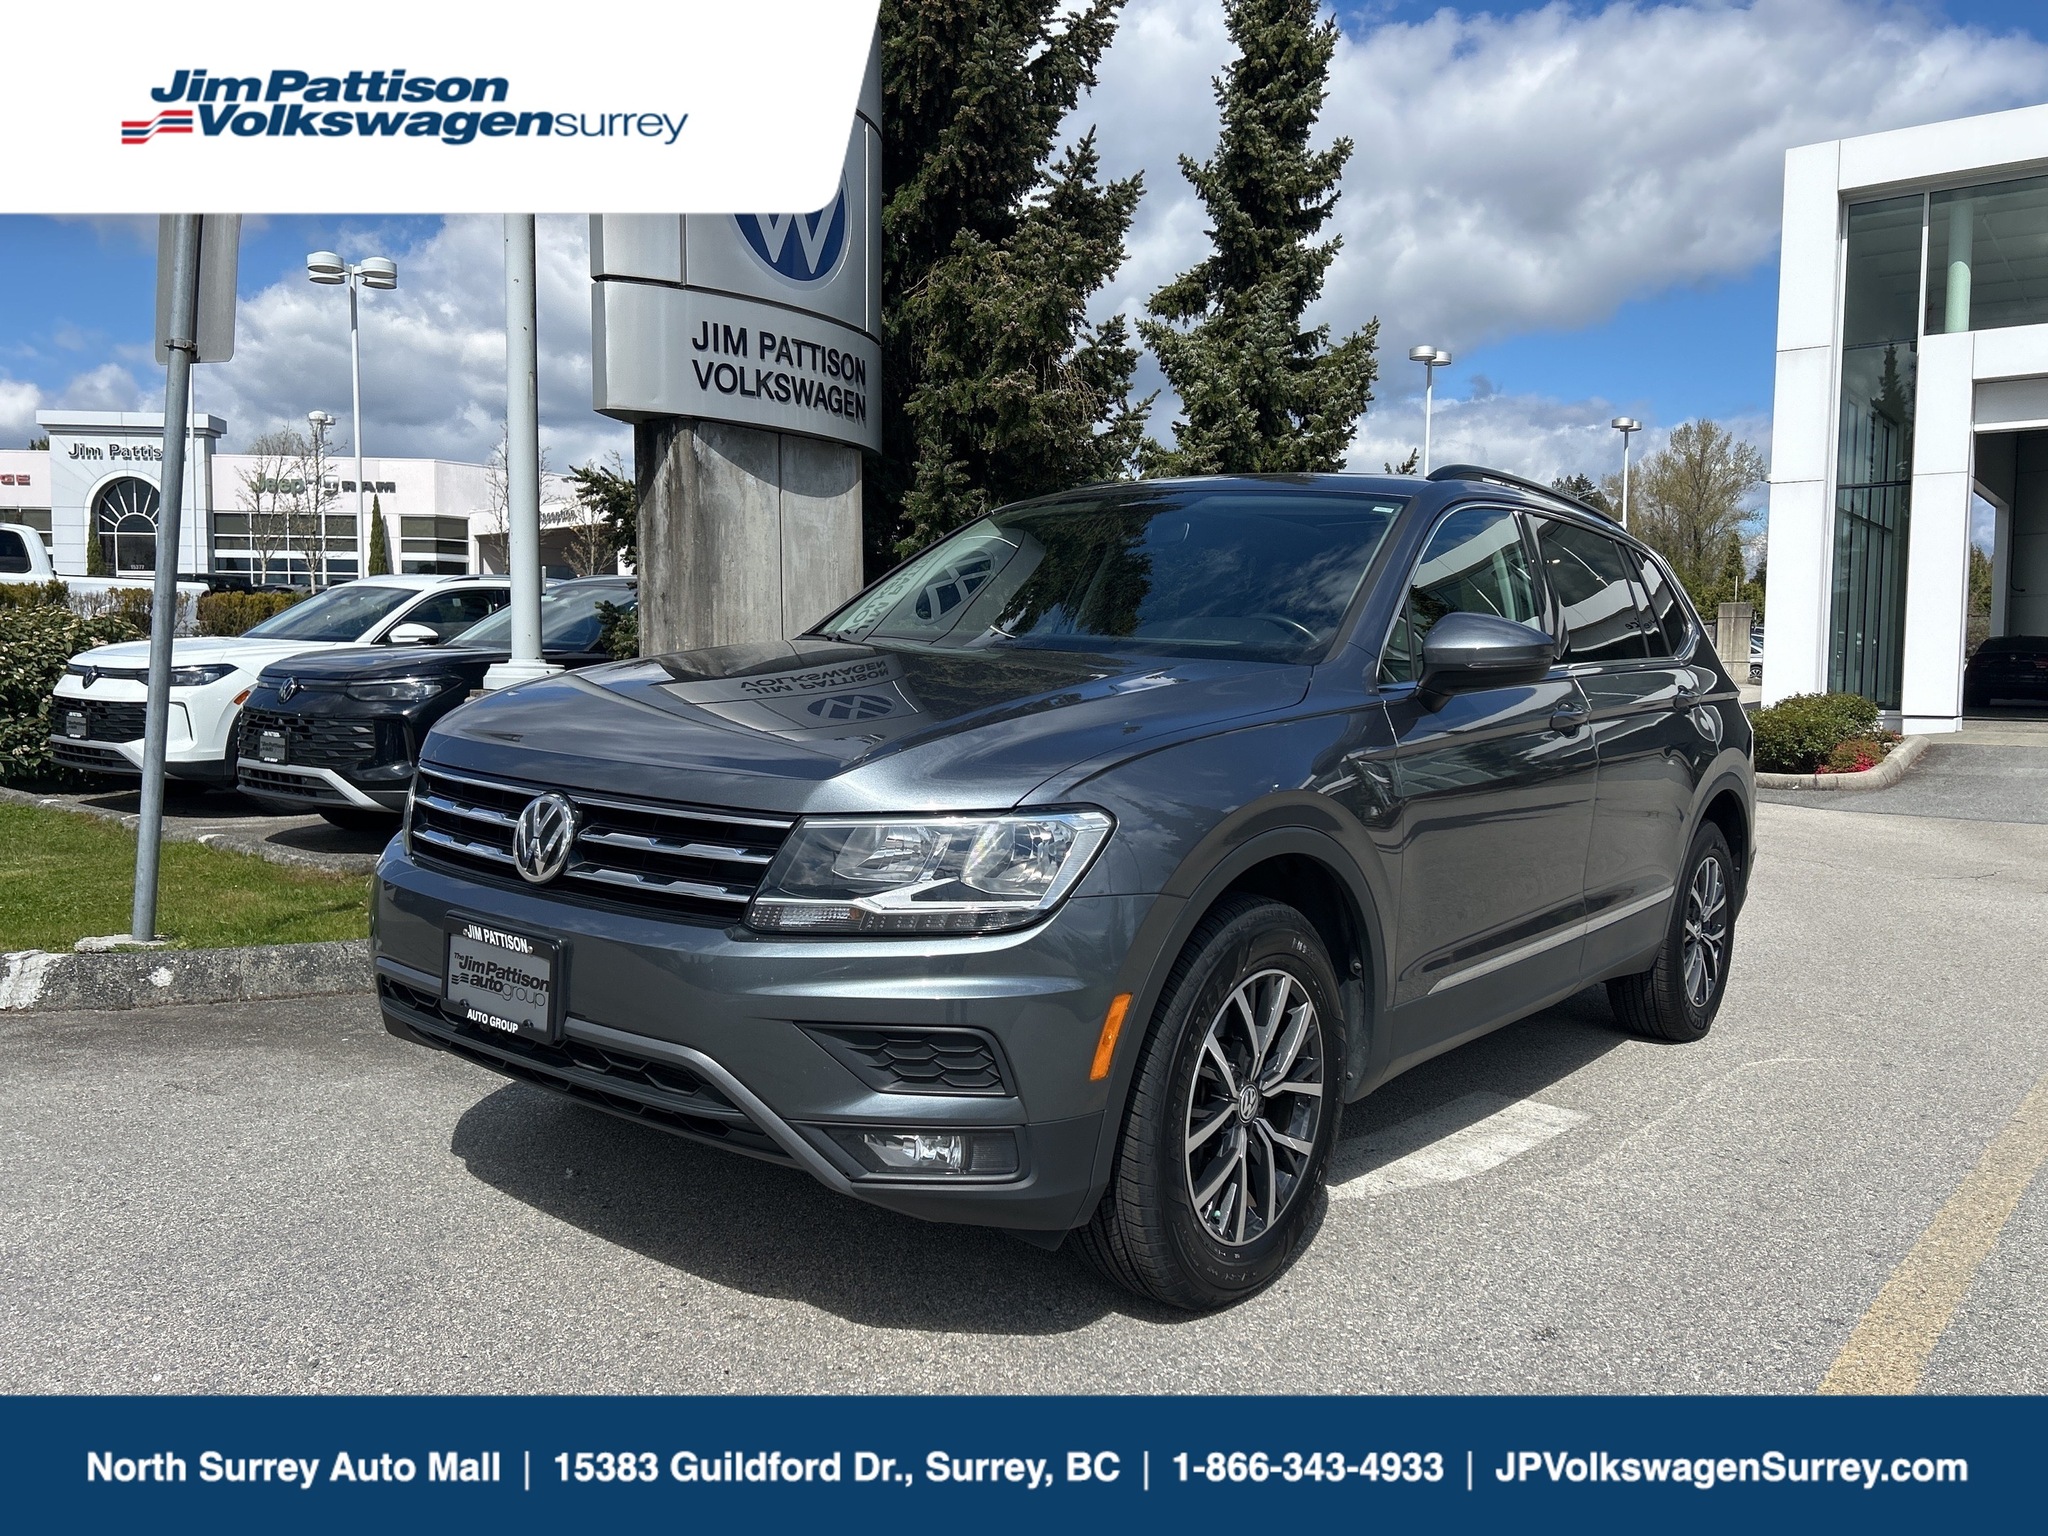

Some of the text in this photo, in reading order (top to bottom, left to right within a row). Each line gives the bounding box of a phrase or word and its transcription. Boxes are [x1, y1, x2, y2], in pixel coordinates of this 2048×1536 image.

[692, 320, 866, 387] JIM PATTISON
[691, 359, 867, 422] VOLKSWAGEN
[68, 443, 163, 462] Jim Pattis
[250, 473, 397, 498] Jeep RAM
[467, 924, 529, 954] JIM PATTISON
[467, 1008, 519, 1034] AUTO GROUP
